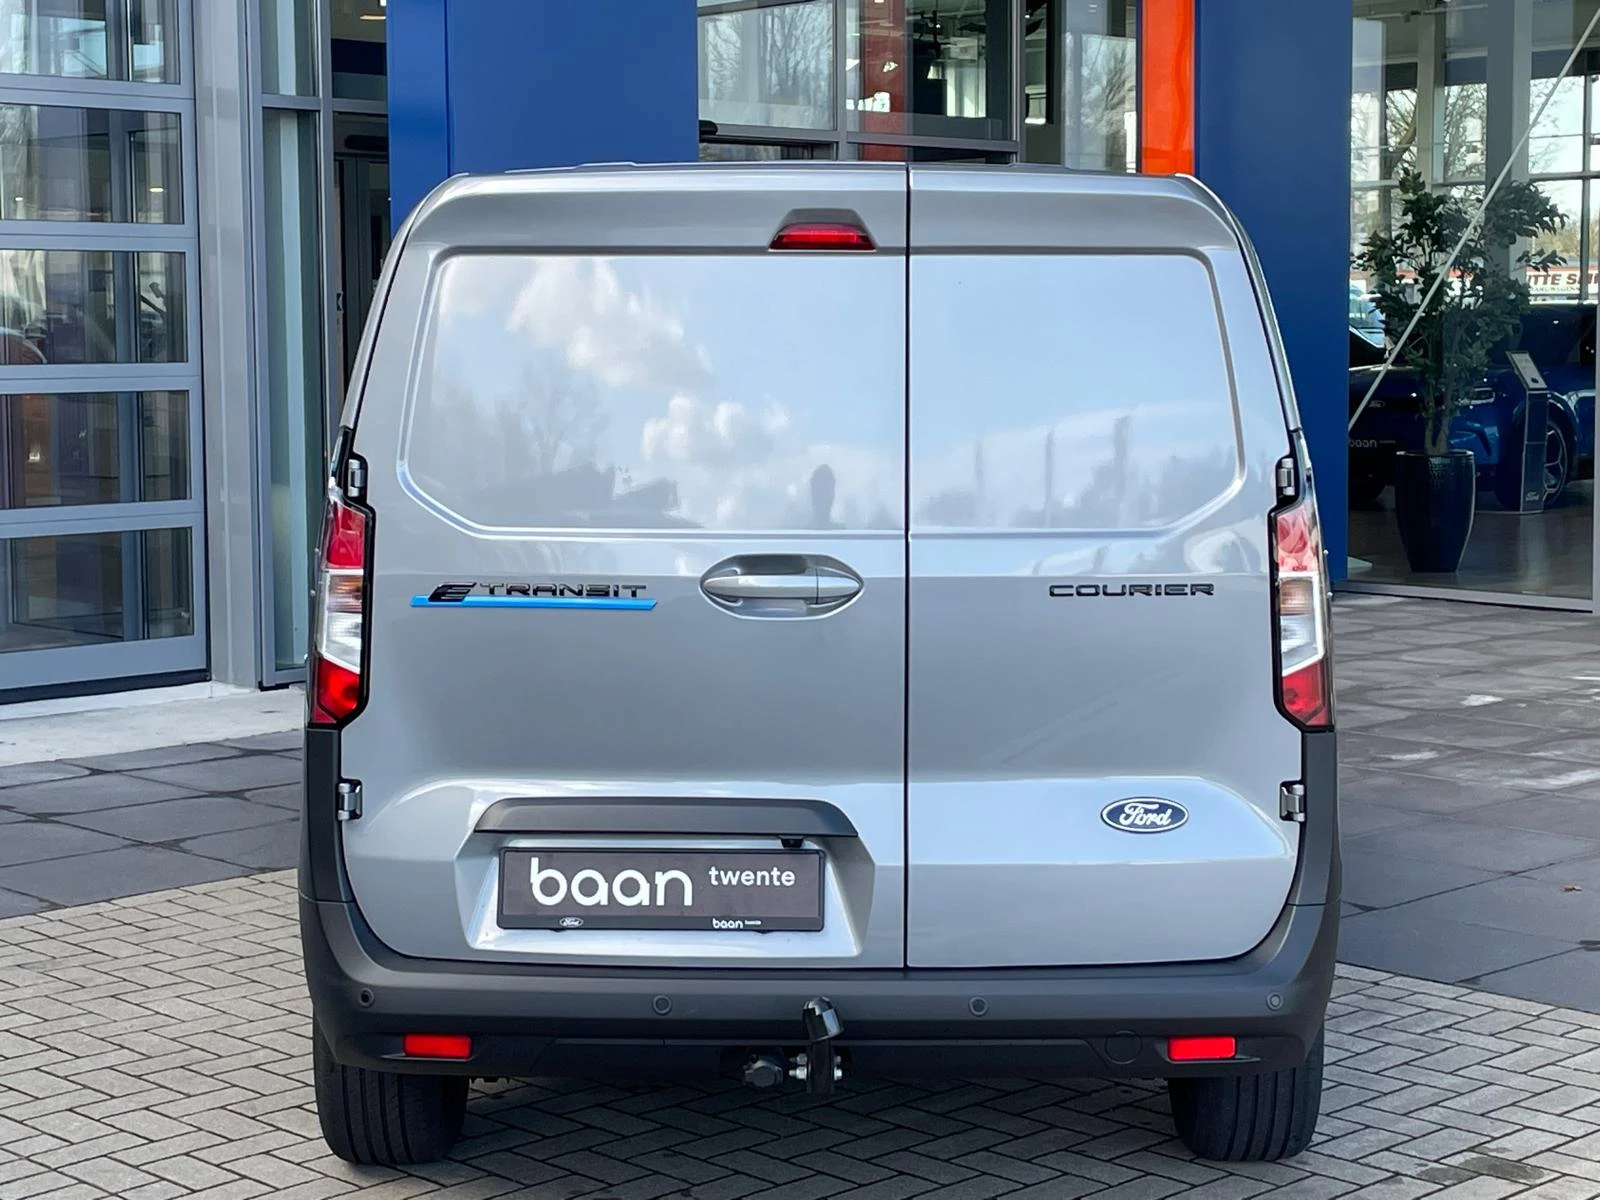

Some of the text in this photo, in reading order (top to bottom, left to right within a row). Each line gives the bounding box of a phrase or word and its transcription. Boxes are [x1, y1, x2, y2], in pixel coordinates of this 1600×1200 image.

[480, 583, 647, 598] TRANSIT
[1049, 583, 1215, 597] COURIER
[1119, 802, 1173, 826] Ford
[530, 857, 796, 906] baan twente
[712, 918, 744, 929] baan
